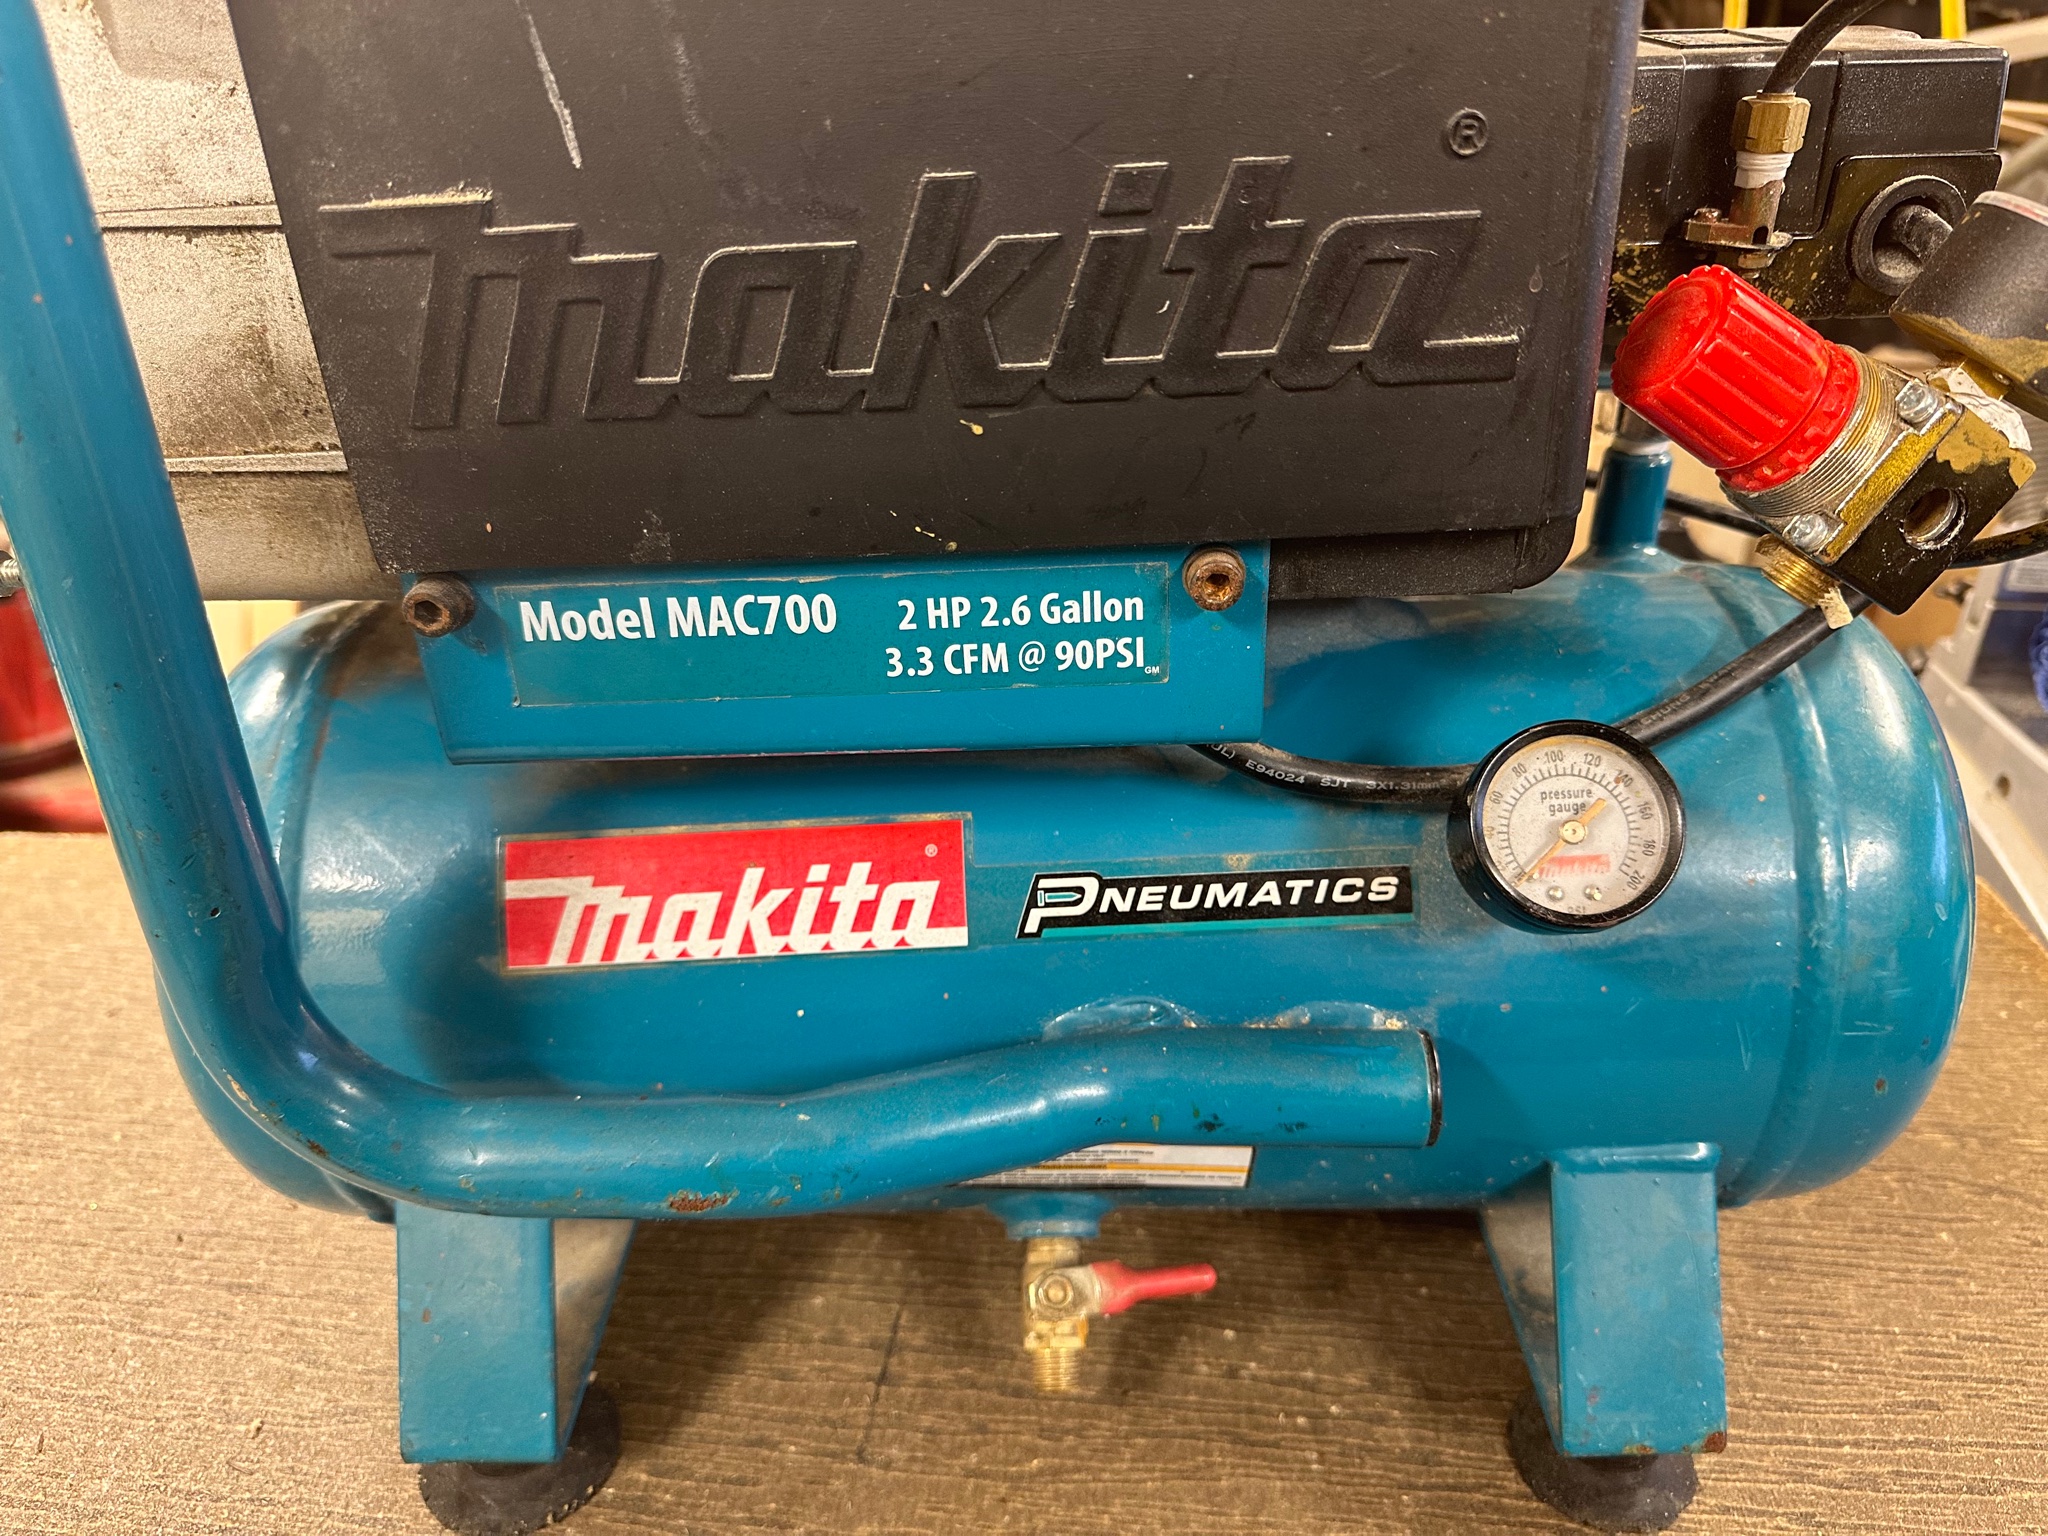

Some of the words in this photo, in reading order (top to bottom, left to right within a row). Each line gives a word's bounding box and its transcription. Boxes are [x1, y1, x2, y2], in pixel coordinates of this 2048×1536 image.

[519, 597, 656, 642] Model
[666, 593, 837, 638] MAC700
[897, 599, 917, 631] 2
[926, 597, 971, 630] HP
[980, 595, 1032, 627] 2.6
[1039, 590, 1144, 625] Gallon
[885, 646, 934, 678] 3.3
[943, 642, 1009, 675] CFM
[1018, 640, 1046, 673] @
[1054, 636, 1145, 671] 90PSI
[1544, 750, 1564, 763] 100
[1583, 752, 1602, 768] 120
[1245, 759, 1305, 785] E94024
[1320, 777, 1350, 789] SJT
[1511, 763, 1527, 778] 80
[1489, 790, 1504, 806] 60
[1540, 787, 1593, 802] pressure
[1549, 801, 1587, 817] gauge
[1637, 802, 1652, 821] 160
[1643, 839, 1656, 857] 180
[1626, 870, 1646, 891] 200
[505, 861, 968, 967] makita
[1024, 876, 1400, 933] PNEUMATICS
